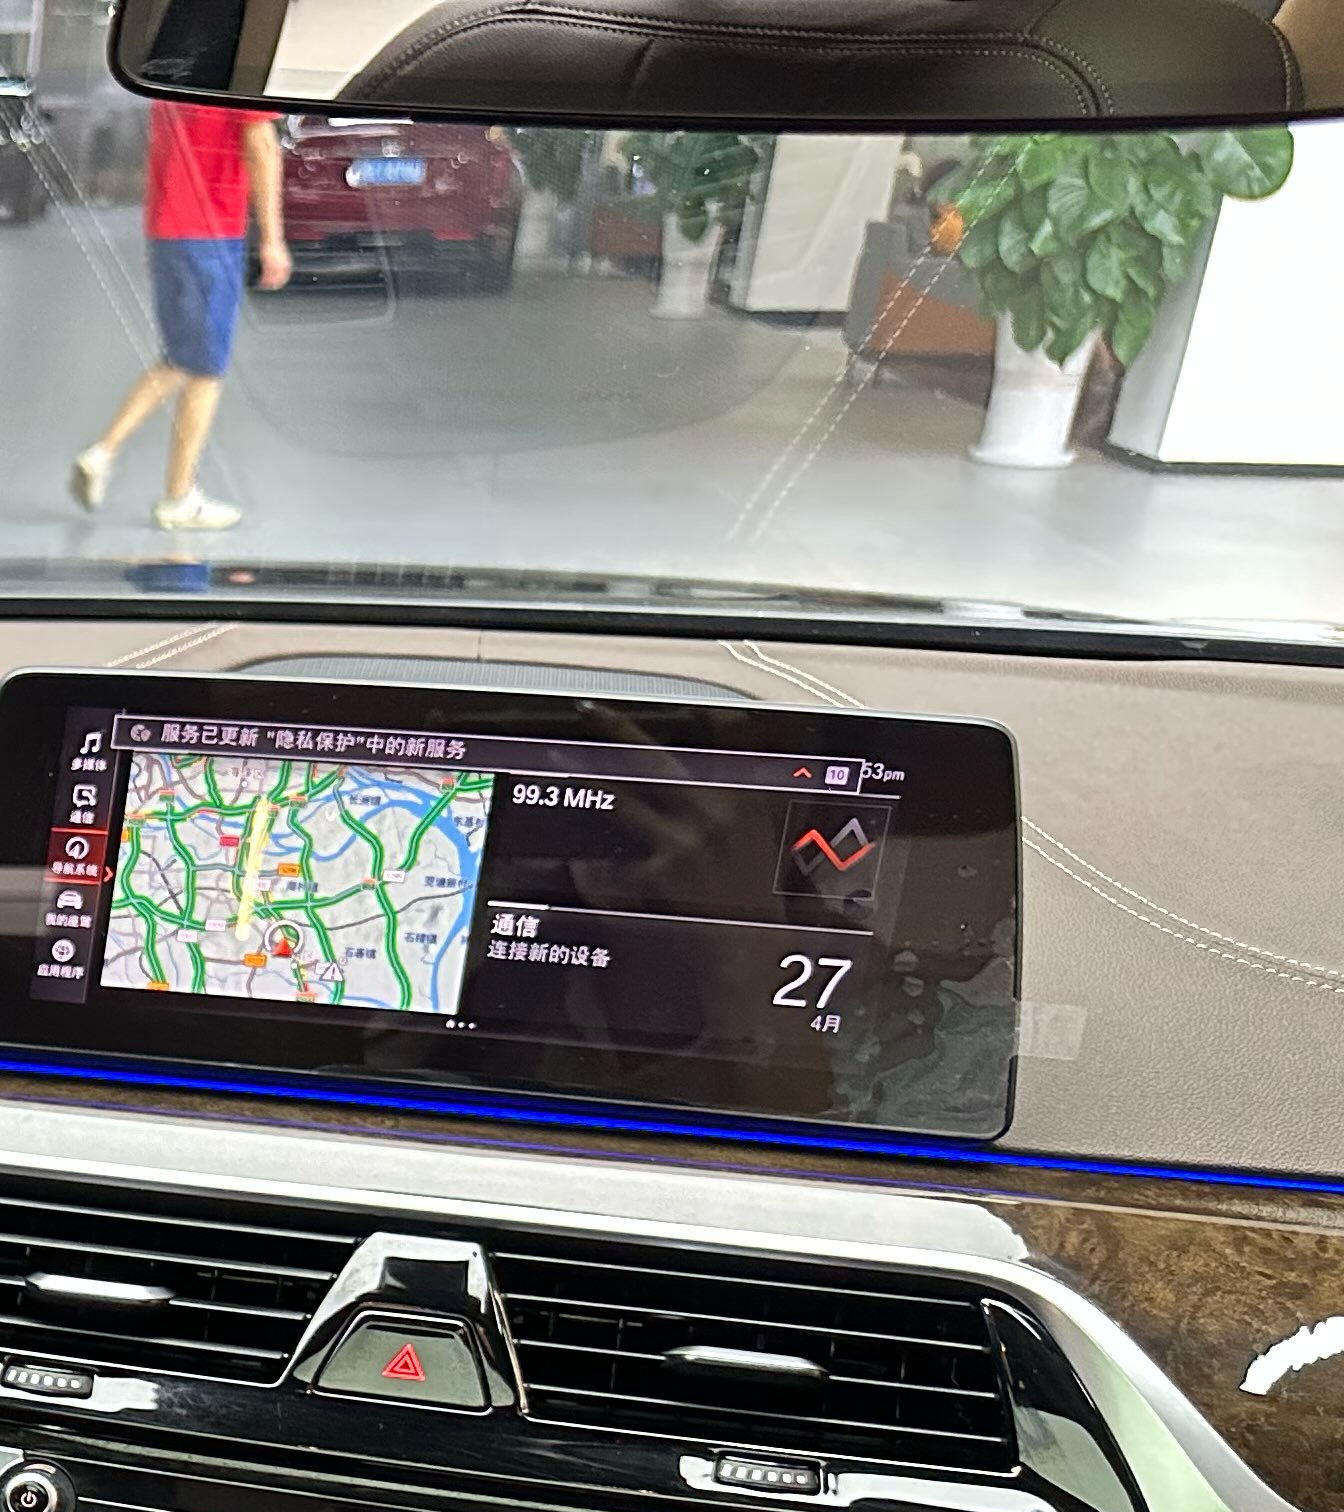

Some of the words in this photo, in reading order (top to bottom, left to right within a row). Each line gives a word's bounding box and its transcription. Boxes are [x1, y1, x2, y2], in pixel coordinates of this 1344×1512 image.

[161, 722, 258, 749] 服务已更新
[512, 785, 559, 807] 99.3
[564, 788, 615, 810] MHz
[490, 913, 541, 939] 通信
[487, 939, 612, 969] 连接新的设备
[772, 954, 853, 1010] 27
[810, 1014, 842, 1034] 4月
